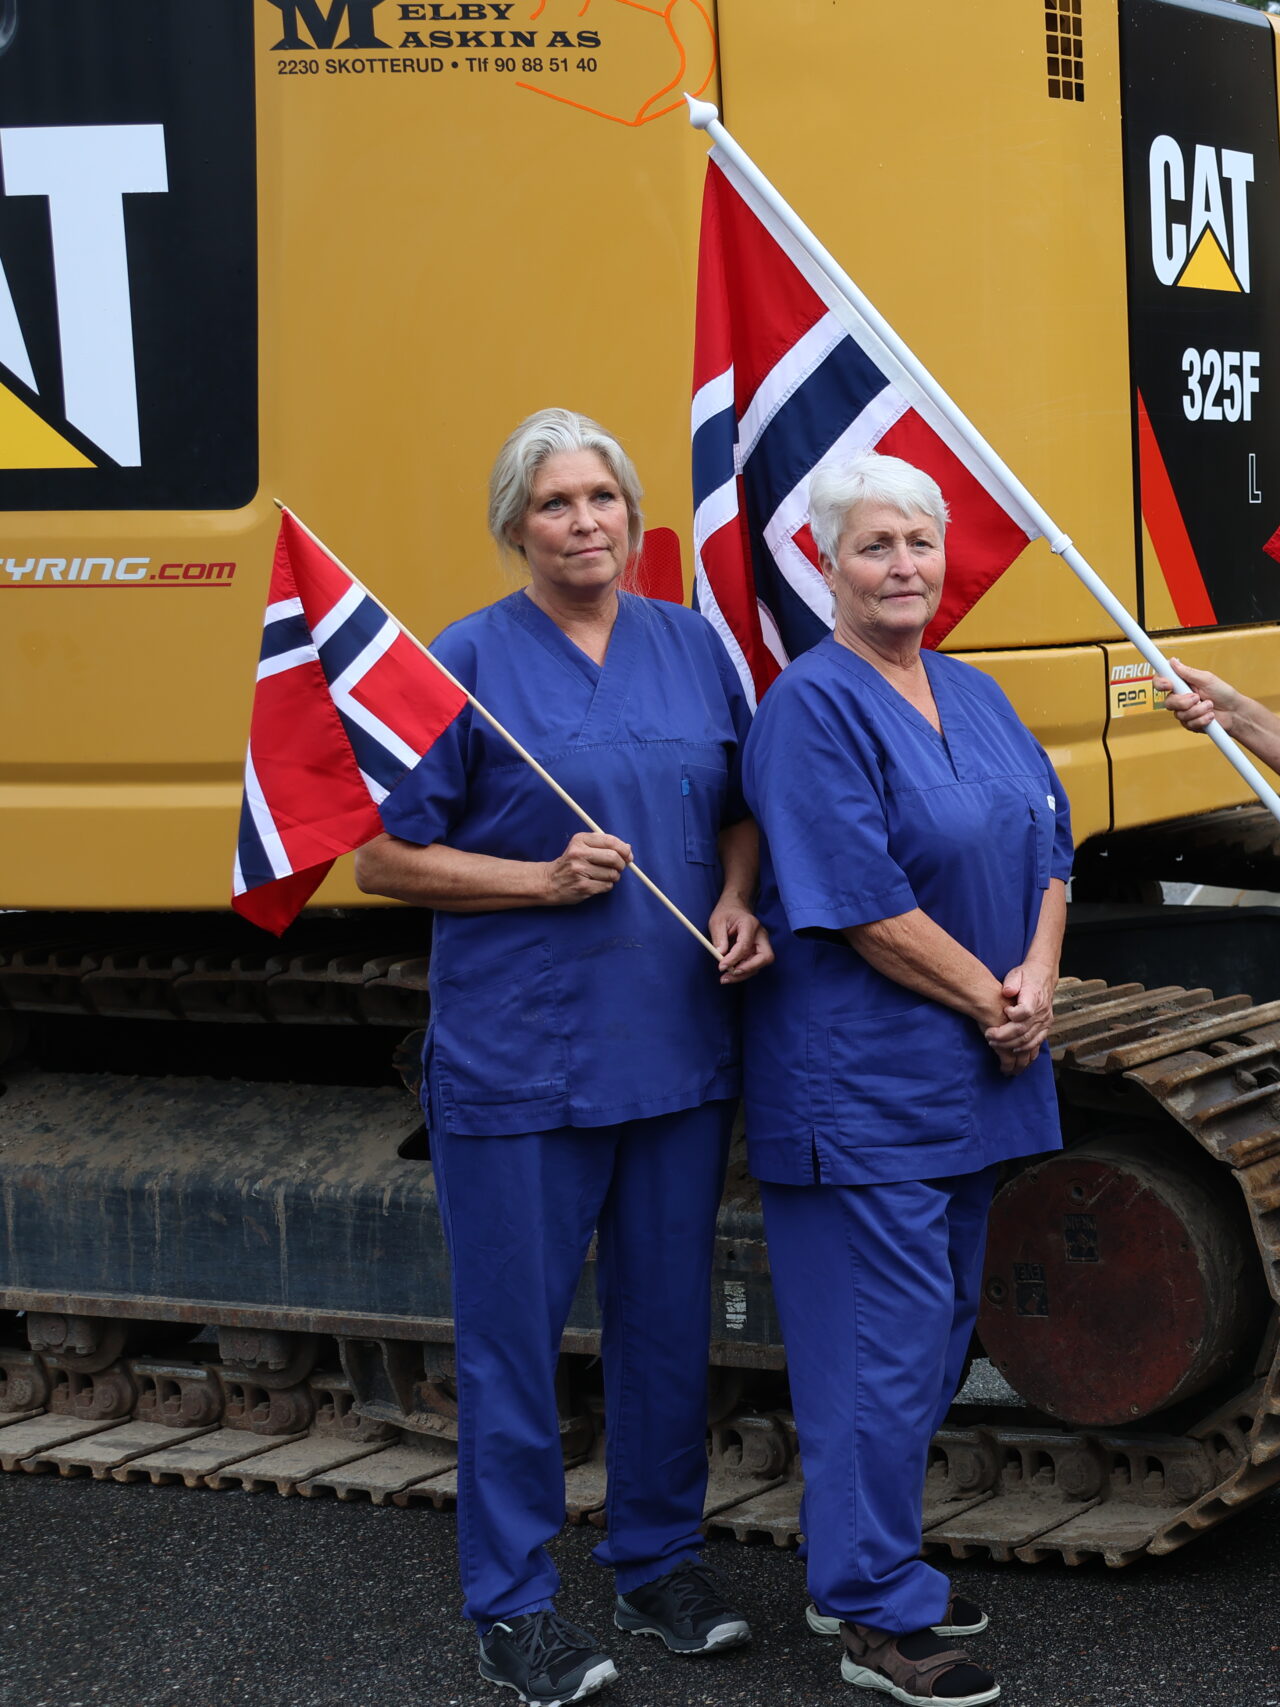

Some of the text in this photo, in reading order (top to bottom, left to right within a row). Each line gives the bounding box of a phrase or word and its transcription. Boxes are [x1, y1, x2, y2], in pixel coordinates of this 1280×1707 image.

[546, 30, 601, 49] AS
[277, 57, 598, 75] 2230 SKOTTERUD Tlf 90 88 51 40
[1149, 134, 1255, 293] CAT
[0, 123, 169, 468] T
[1182, 348, 1260, 422] 325F
[1249, 453, 1261, 503] L
[0, 557, 236, 581] YRING.com
